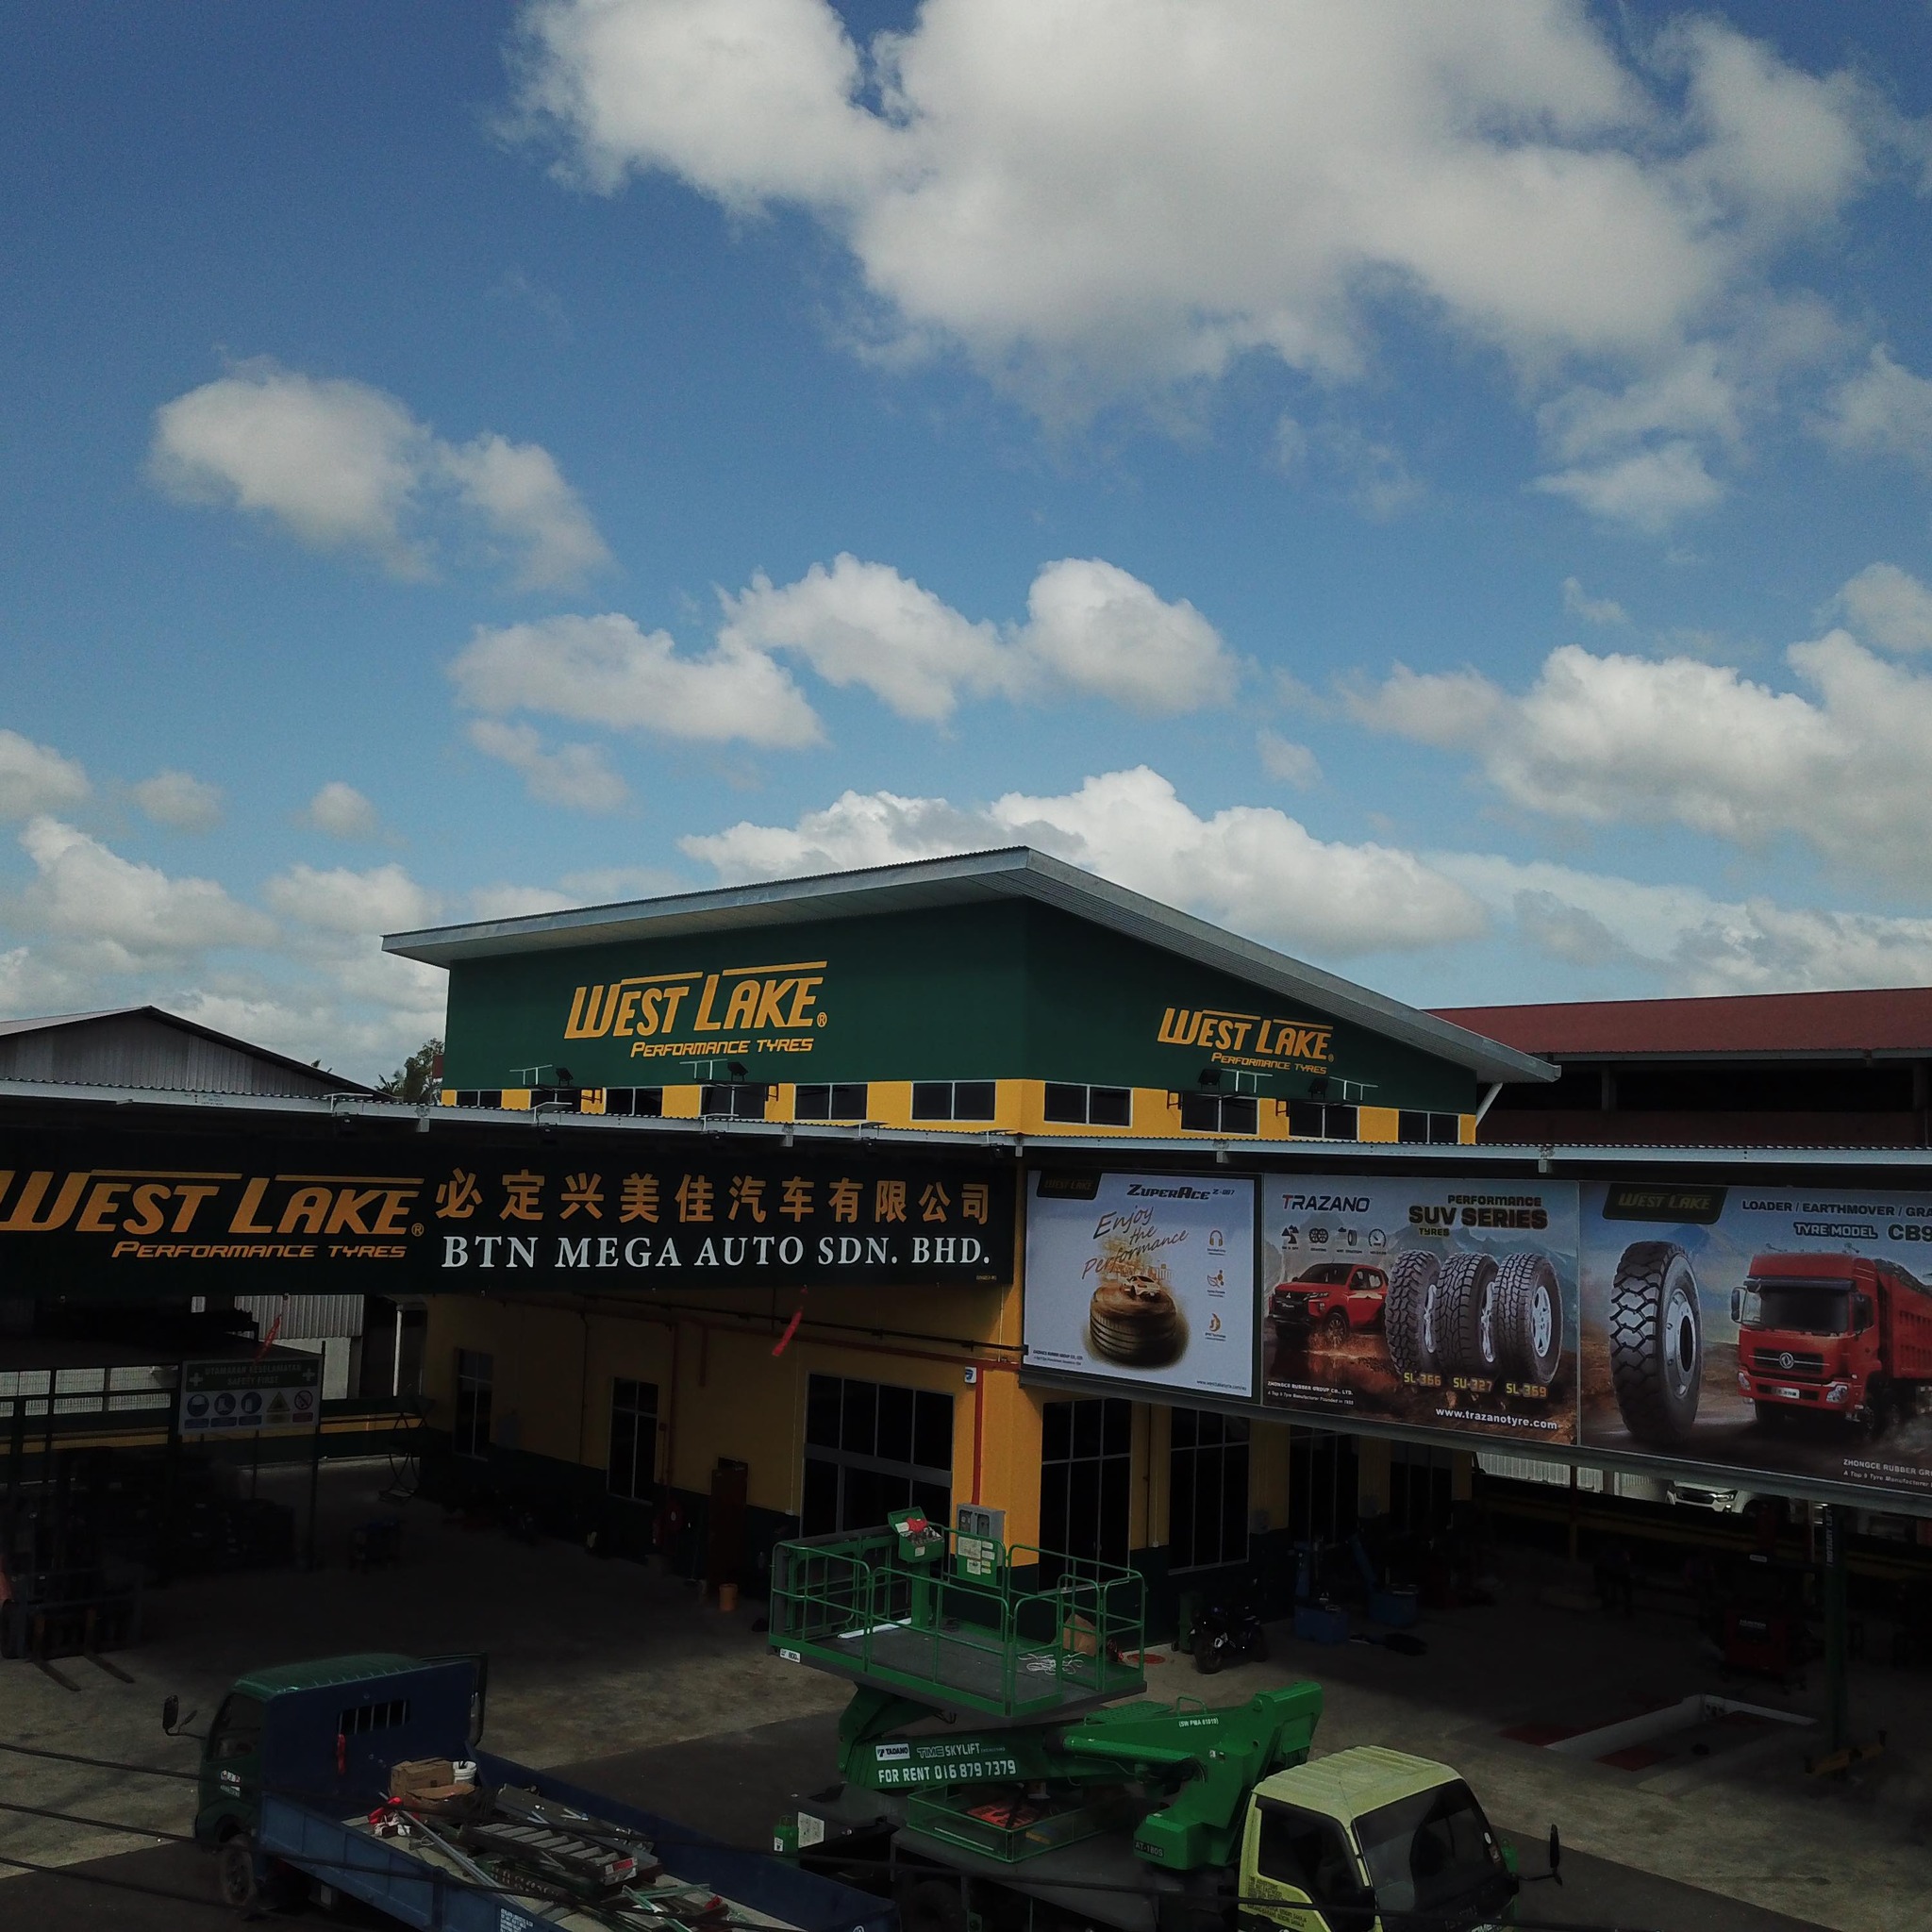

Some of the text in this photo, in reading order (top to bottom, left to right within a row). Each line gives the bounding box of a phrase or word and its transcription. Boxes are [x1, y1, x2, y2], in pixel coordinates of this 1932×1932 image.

[564, 970, 825, 1040] WEST LAKE
[1158, 1008, 1332, 1060] WEST LAKE
[630, 1038, 814, 1058] PERFORMANCE TYRES
[1211, 1052, 1327, 1074] PERFORMANCE TYRES
[0, 1170, 421, 1235] WEST LAKE
[435, 1167, 990, 1224] 必定兴美佳汽车有限公司
[1283, 1194, 1370, 1212] TRAZANO
[1448, 1194, 1541, 1207] PERFORMANCE
[1619, 1192, 1714, 1209] WEST LAKE
[1408, 1206, 1548, 1229] SUV SERIES
[1742, 1201, 1792, 1211] LOADER
[1803, 1203, 1894, 1215] EARTHMOVER
[1093, 1206, 1154, 1240] Enjoy
[1419, 1227, 1450, 1237] TYRES
[1795, 1224, 1876, 1239] TYRE MODEL
[1130, 1225, 1157, 1245] the
[111, 1241, 407, 1258] PERFORMANCE TYRES
[441, 1236, 990, 1268] BTN MEGA AUTO SDN. BHD.
[1404, 1372, 1548, 1398] SL-366 SU-327 SL-369
[1435, 1407, 1557, 1430] www.trazanotyre.com
[1843, 1458, 1932, 1476] ZHONGCE RUBBER GR
[1886, 1476, 1930, 1487] Manufacturer
[917, 1746, 943, 1758] TIME
[945, 1742, 980, 1757] SKYLIFT
[878, 1759, 1017, 1783] FOR RENT 016 879 7379
